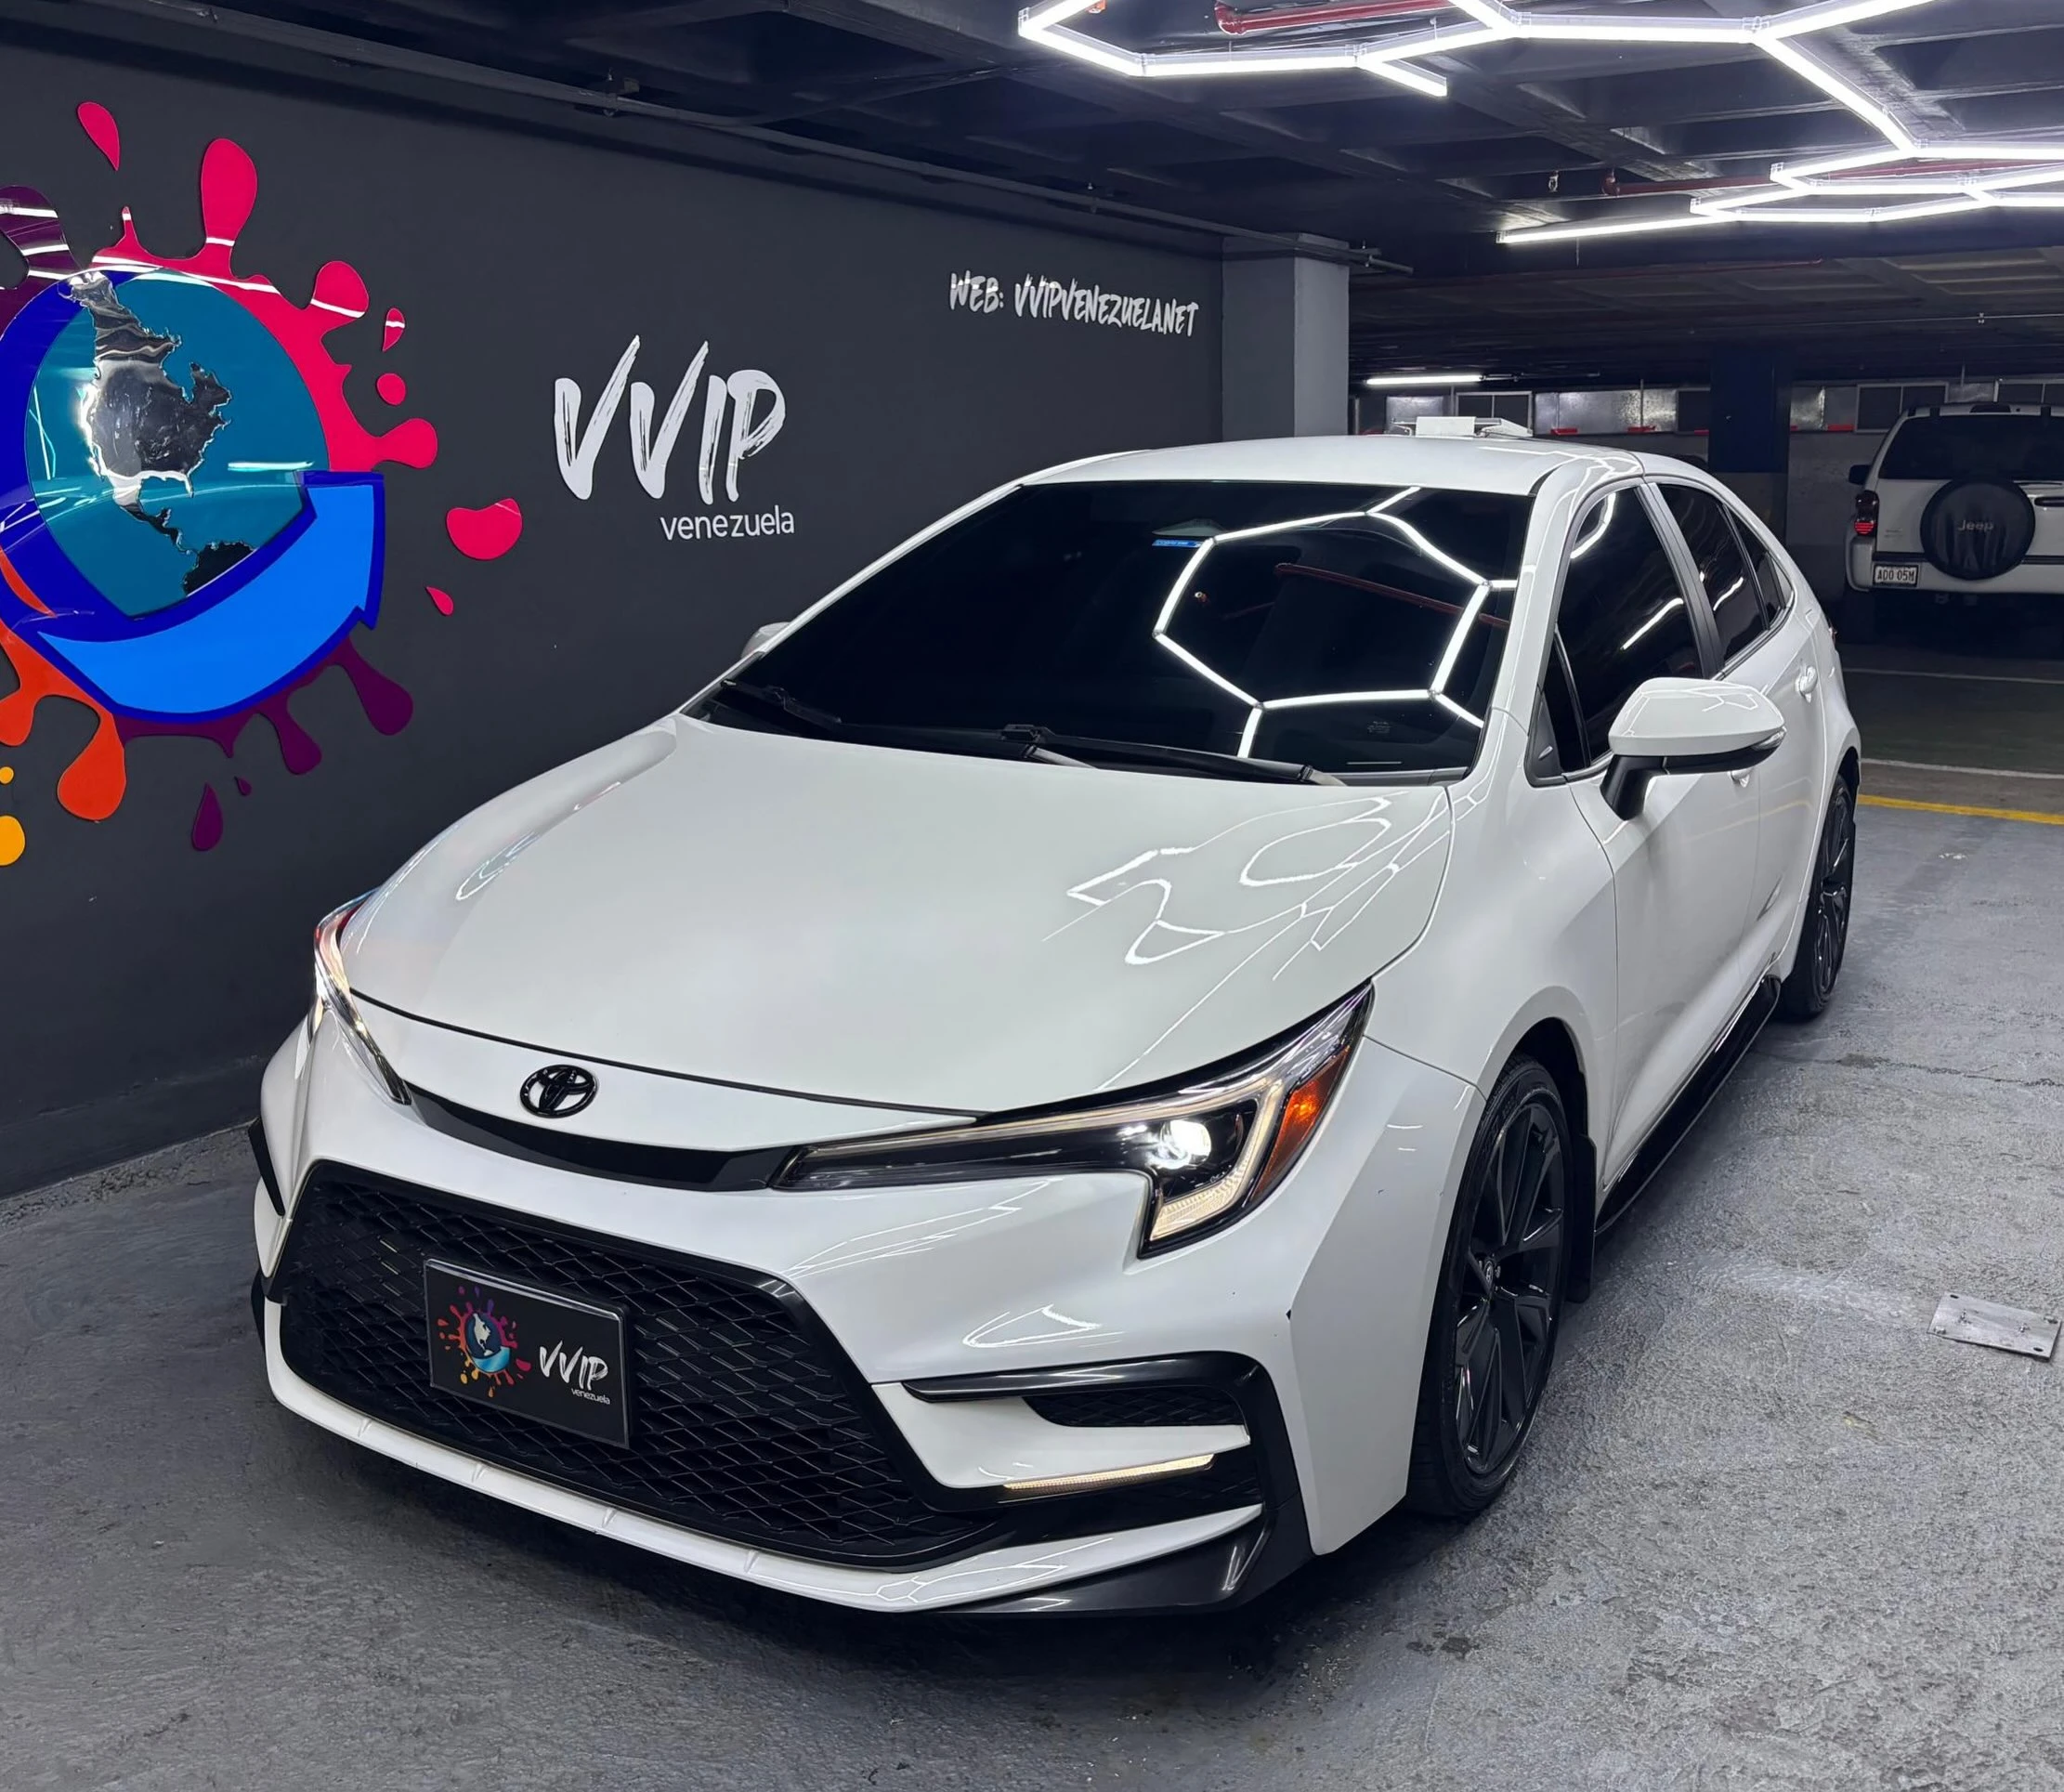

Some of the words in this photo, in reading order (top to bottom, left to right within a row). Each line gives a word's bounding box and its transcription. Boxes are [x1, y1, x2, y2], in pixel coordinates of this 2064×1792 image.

[949, 269, 1004, 313] WEB:
[554, 334, 786, 504] VVIP
[660, 504, 795, 541] venezuela
[1957, 519, 1994, 532] Jeep
[539, 1340, 608, 1391] VVIP
[570, 1387, 611, 1405] venezuela
